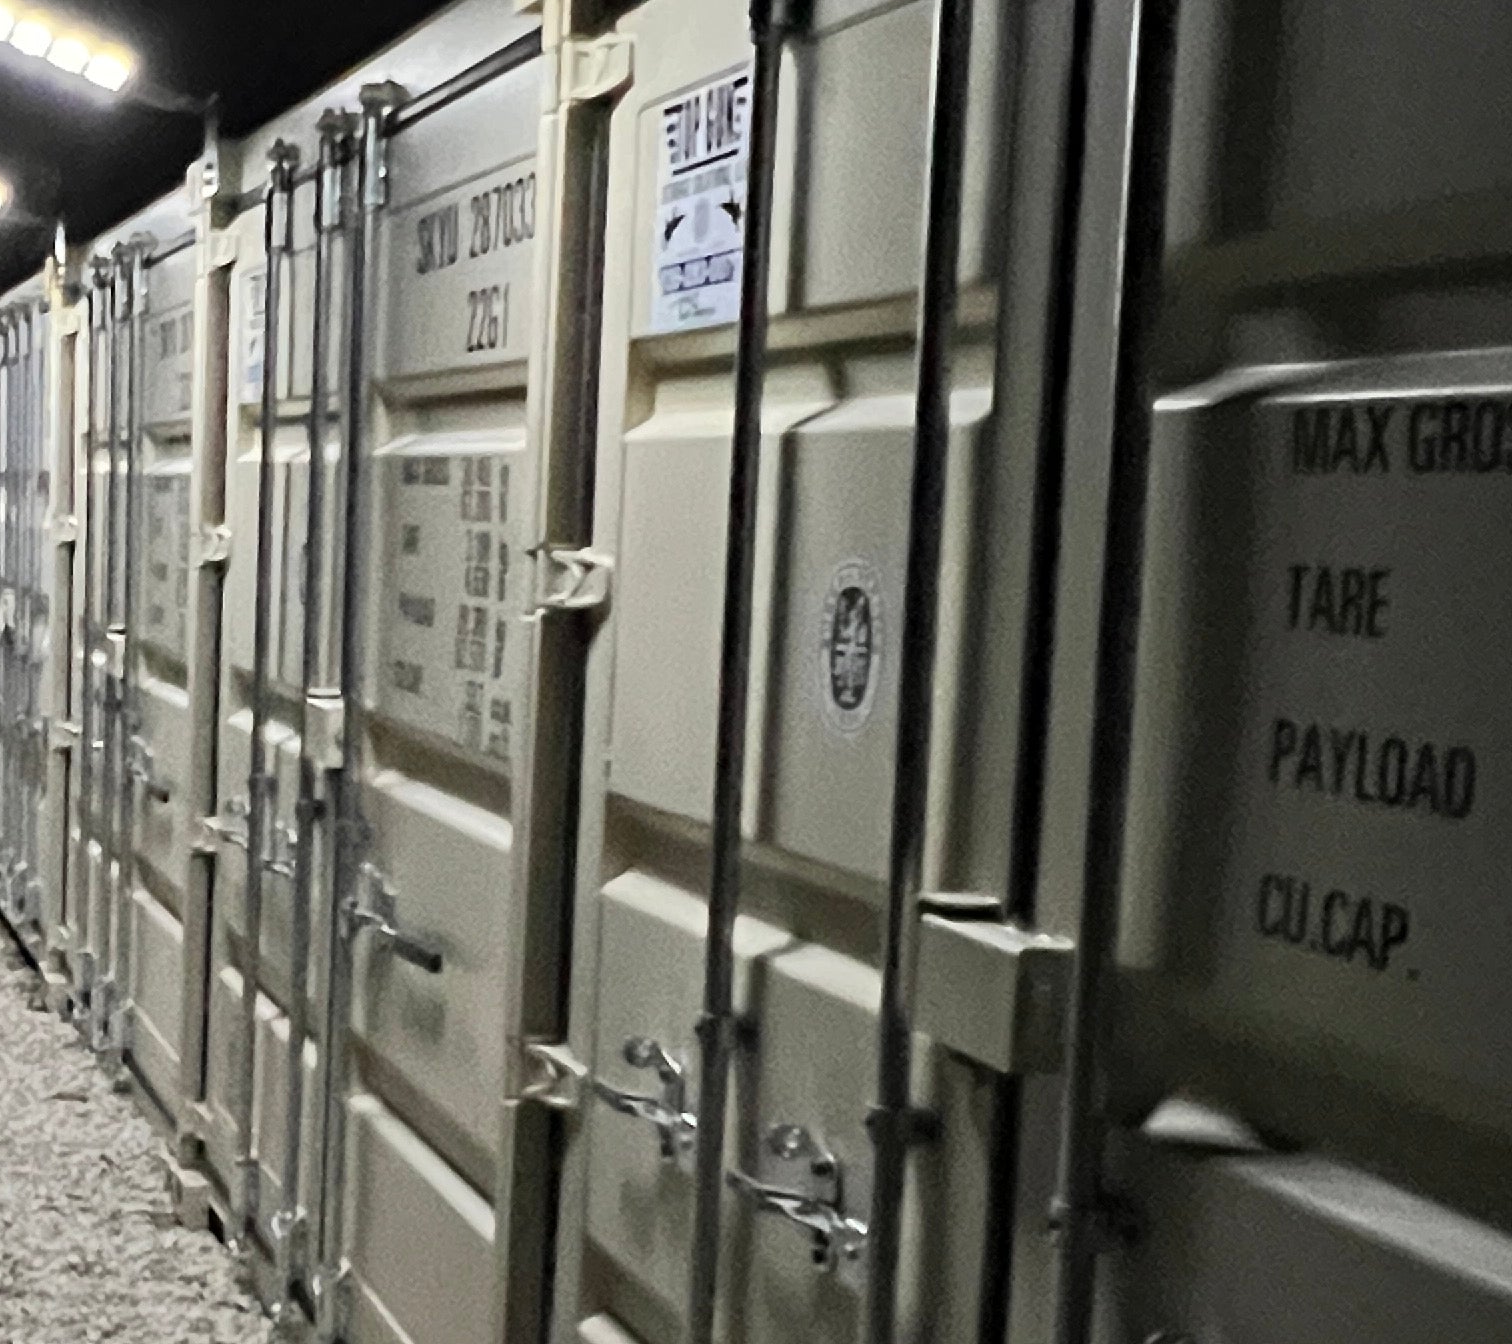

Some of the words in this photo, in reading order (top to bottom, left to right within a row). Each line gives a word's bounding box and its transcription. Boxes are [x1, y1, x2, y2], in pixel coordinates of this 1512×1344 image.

[1294, 405, 1394, 474] MAX
[1288, 565, 1392, 638] TARE
[1269, 718, 1476, 818] PAYLOAD
